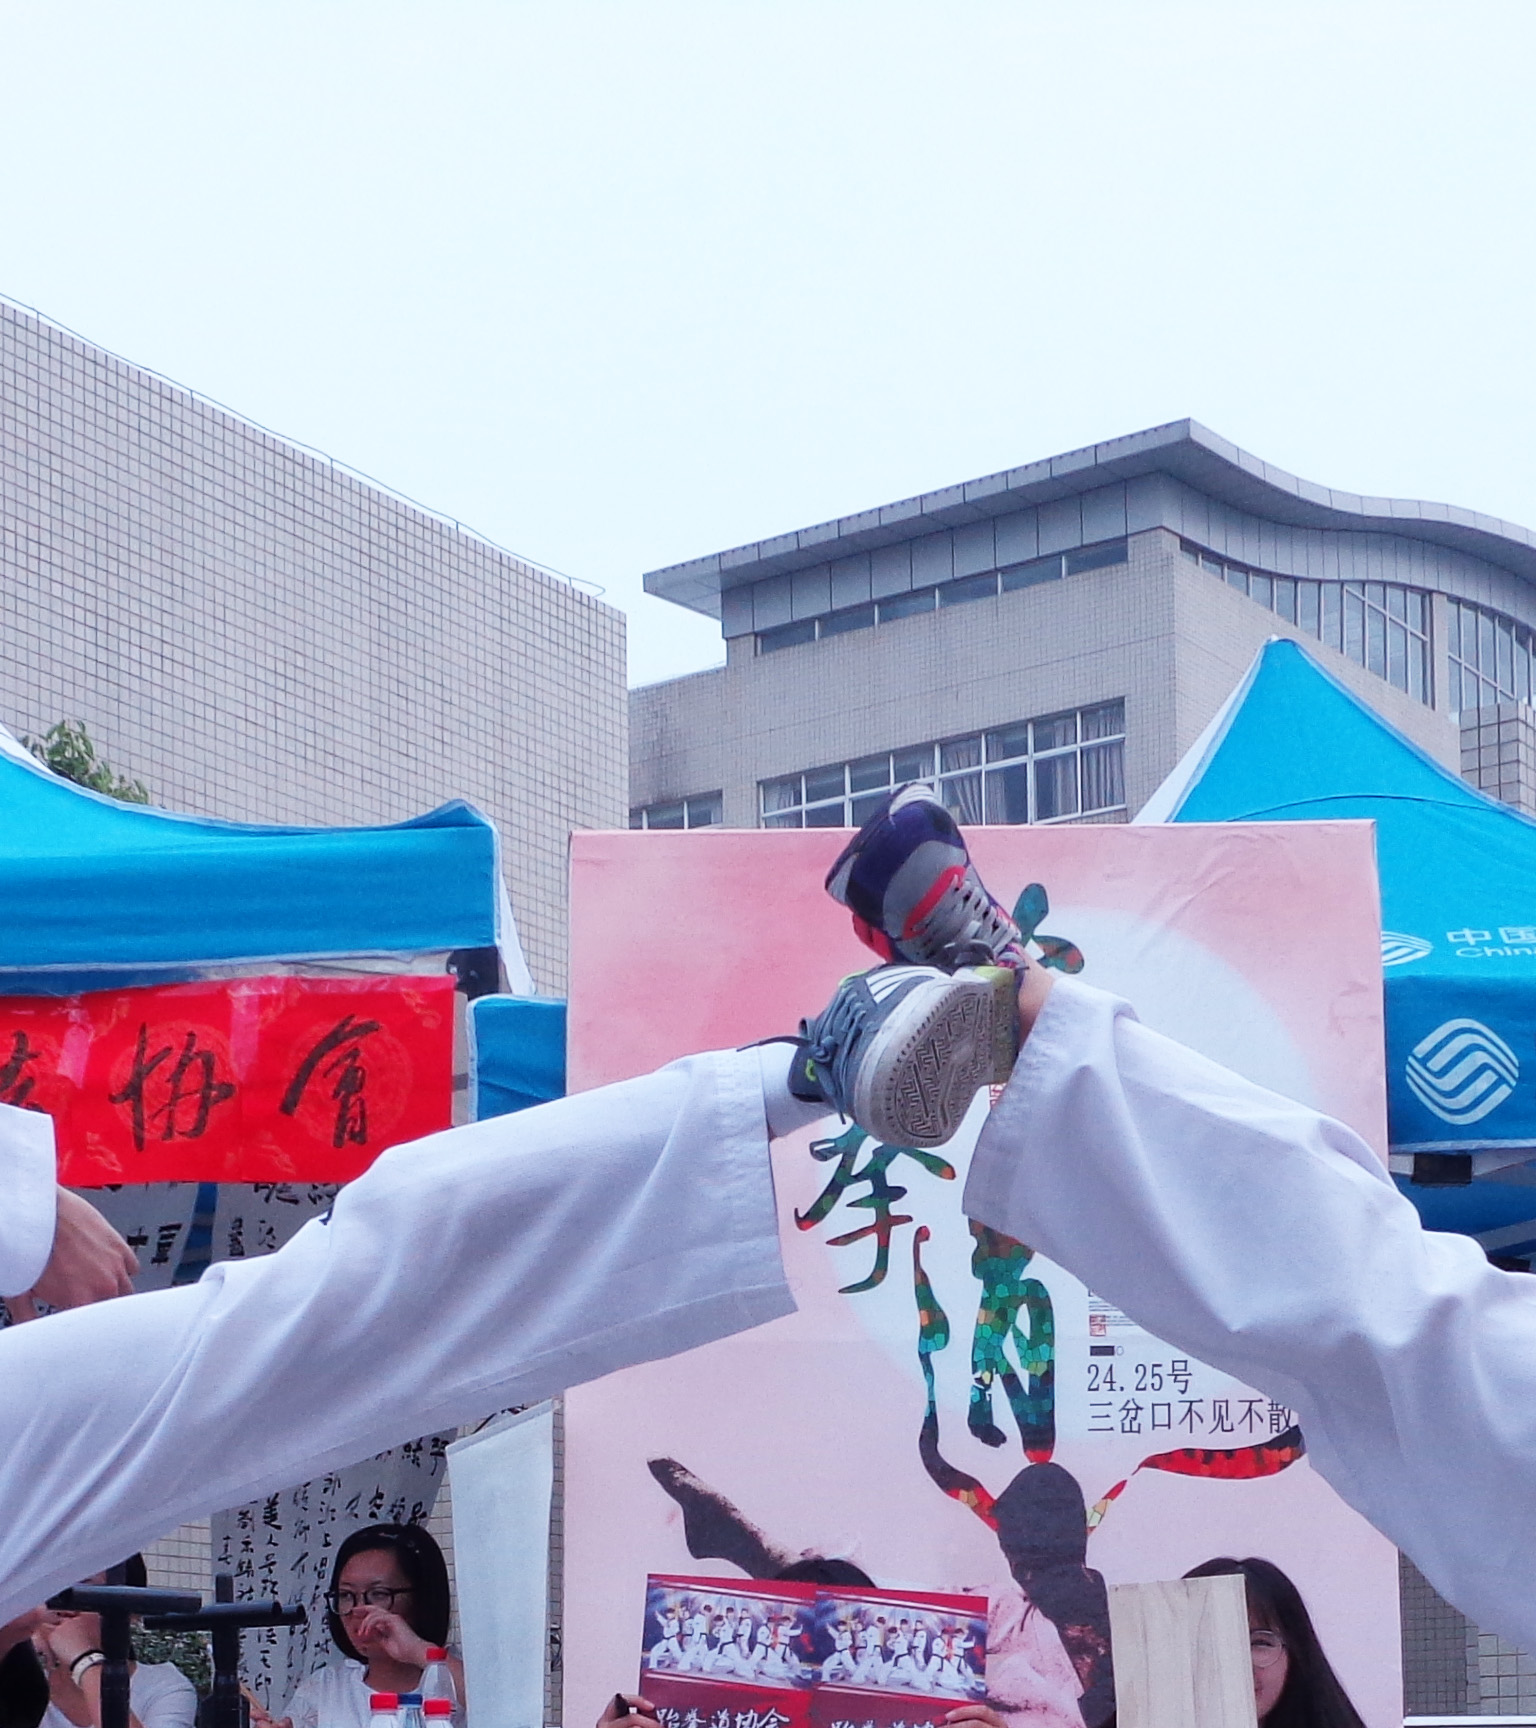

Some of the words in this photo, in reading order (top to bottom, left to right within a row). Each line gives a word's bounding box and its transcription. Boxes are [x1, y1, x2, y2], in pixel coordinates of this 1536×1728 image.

[1086, 1359, 1193, 1395] 24.25号
[1087, 1397, 1293, 1435] 三岔口不见不散
